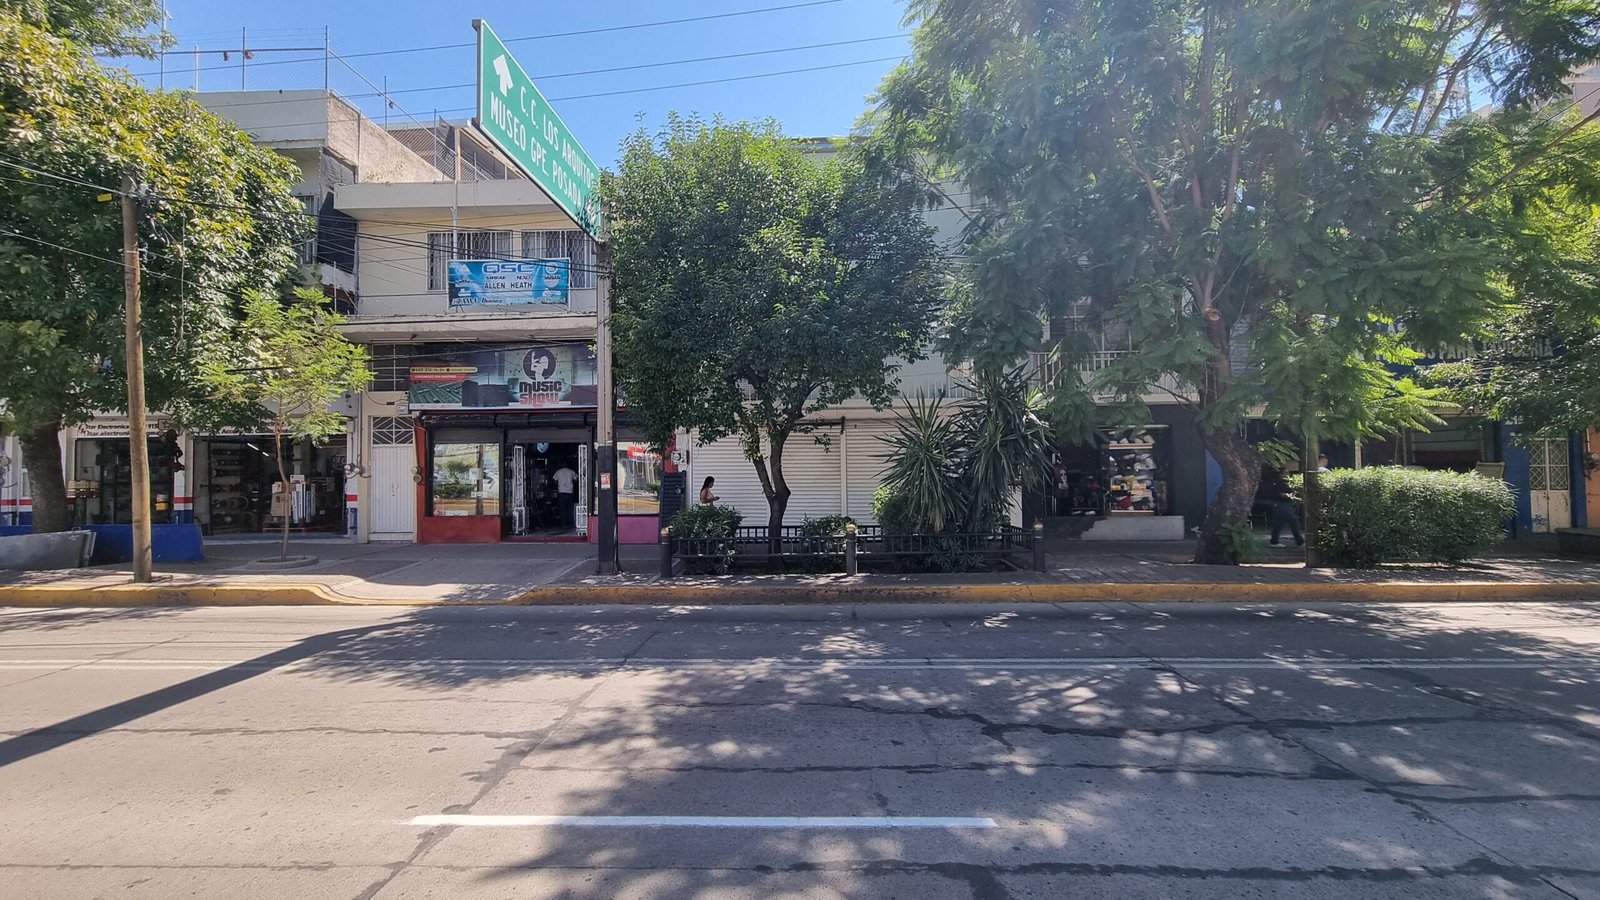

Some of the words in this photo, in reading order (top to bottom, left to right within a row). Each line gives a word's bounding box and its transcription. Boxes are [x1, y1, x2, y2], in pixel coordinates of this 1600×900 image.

[543, 114, 559, 151] LOS
[490, 91, 526, 151] MUSEO
[530, 136, 549, 177] GPE.
[552, 159, 582, 208] POSADA
[482, 262, 536, 274] QSC
[484, 282, 506, 290] ALLEN
[510, 281, 533, 289] HEATH
[519, 391, 560, 406] SHOW
